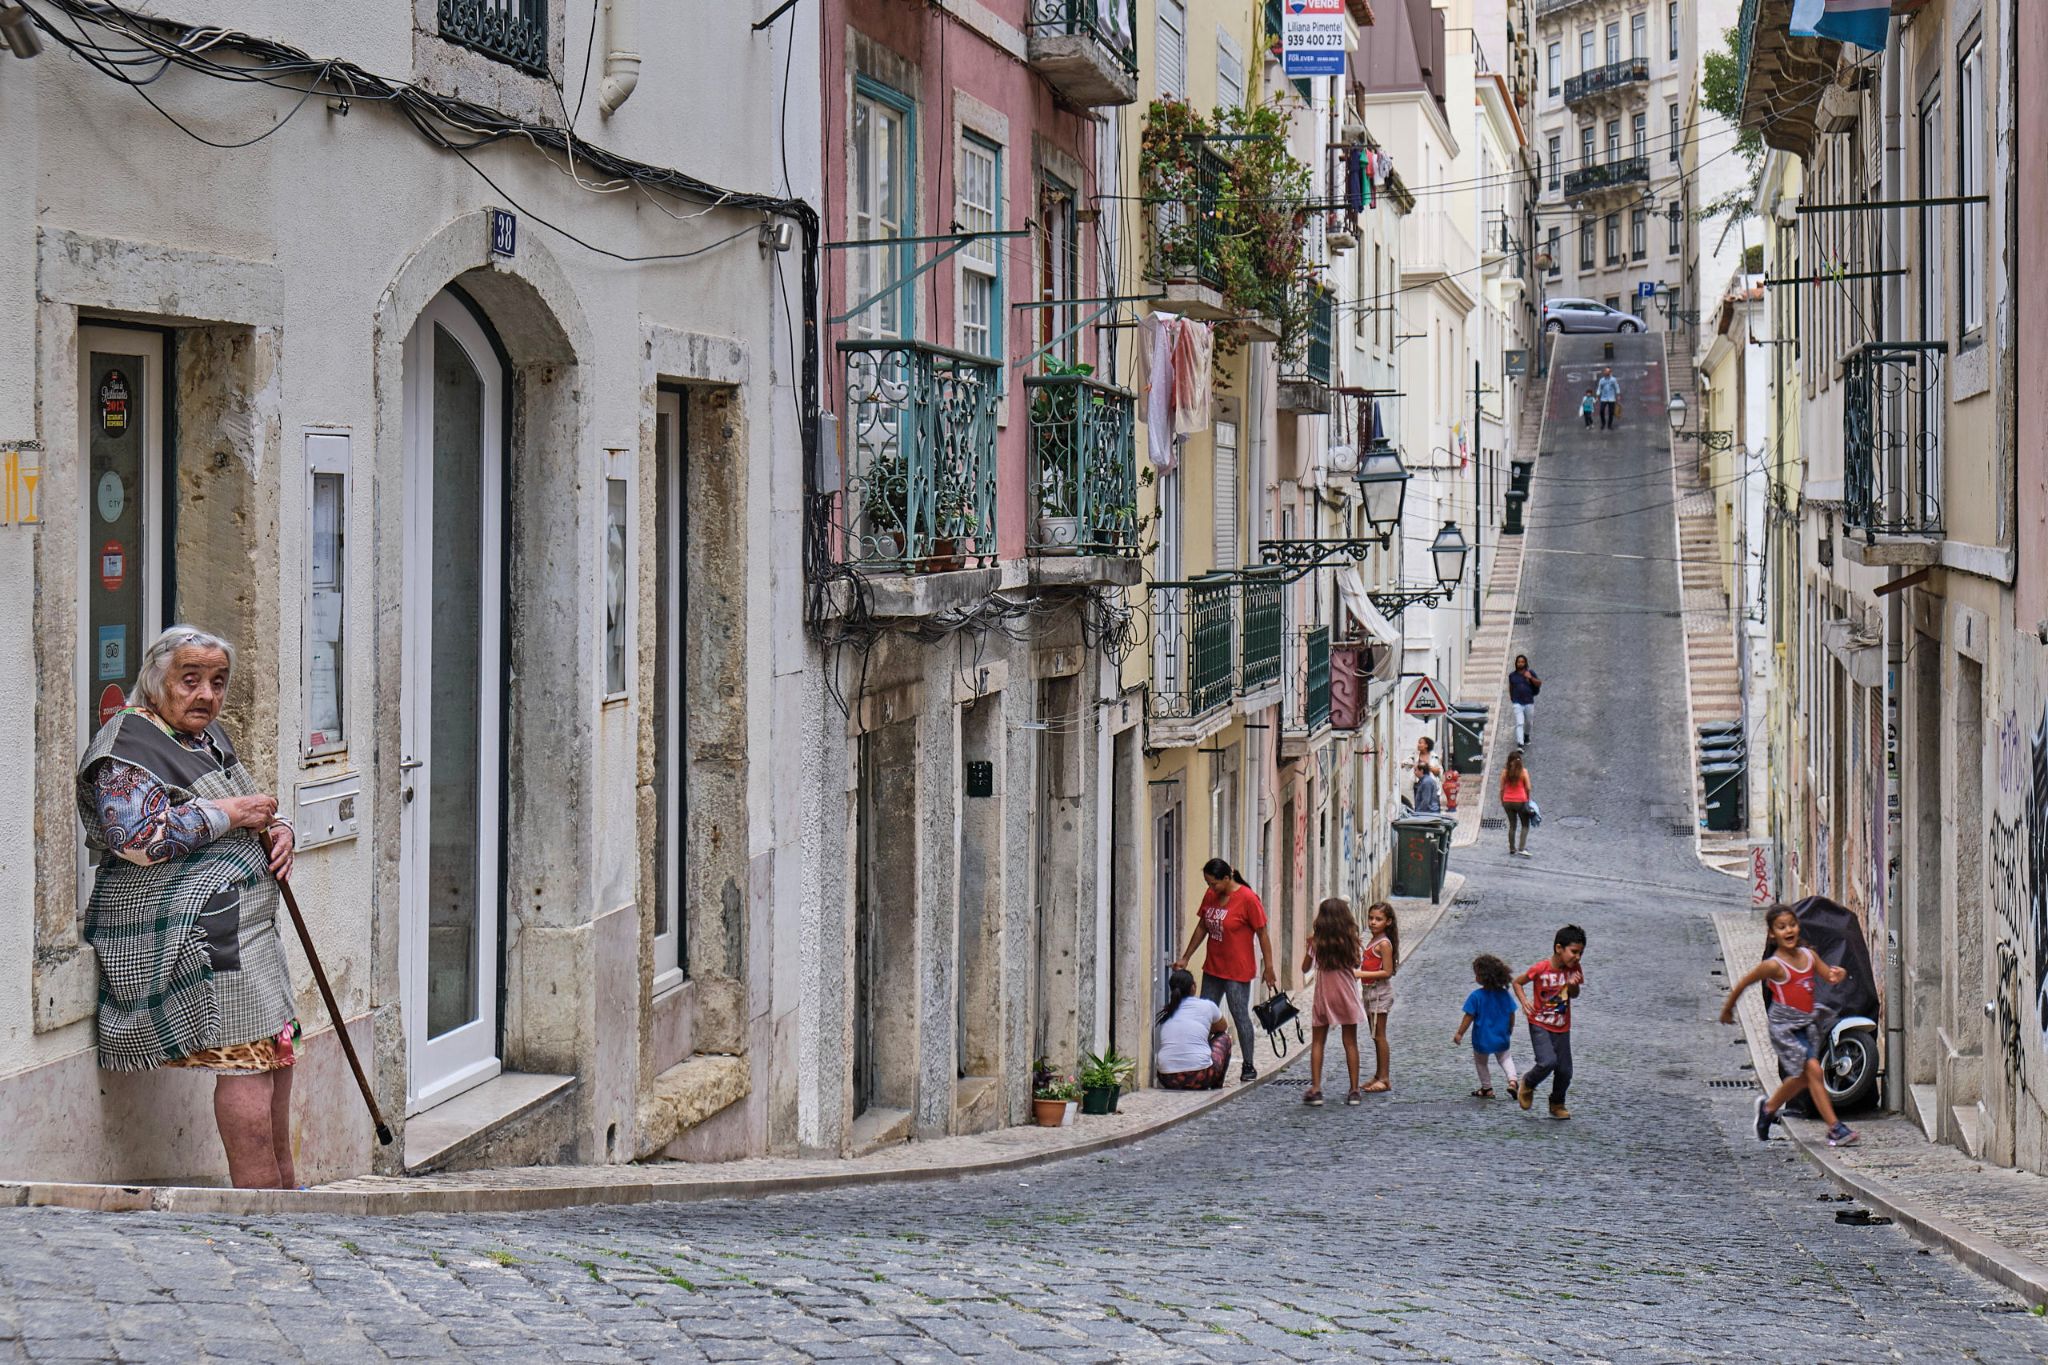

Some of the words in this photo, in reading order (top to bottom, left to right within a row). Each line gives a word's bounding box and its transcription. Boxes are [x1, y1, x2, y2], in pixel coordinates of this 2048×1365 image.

[1313, 22, 1342, 32] Pimentel
[1287, 34, 1304, 46] 939
[1306, 34, 1325, 46] 400
[1326, 34, 1342, 46] 273
[498, 214, 512, 250] 38
[1642, 283, 1651, 296] P
[1567, 368, 1648, 382] STP
[1540, 972, 1568, 987] TEA
